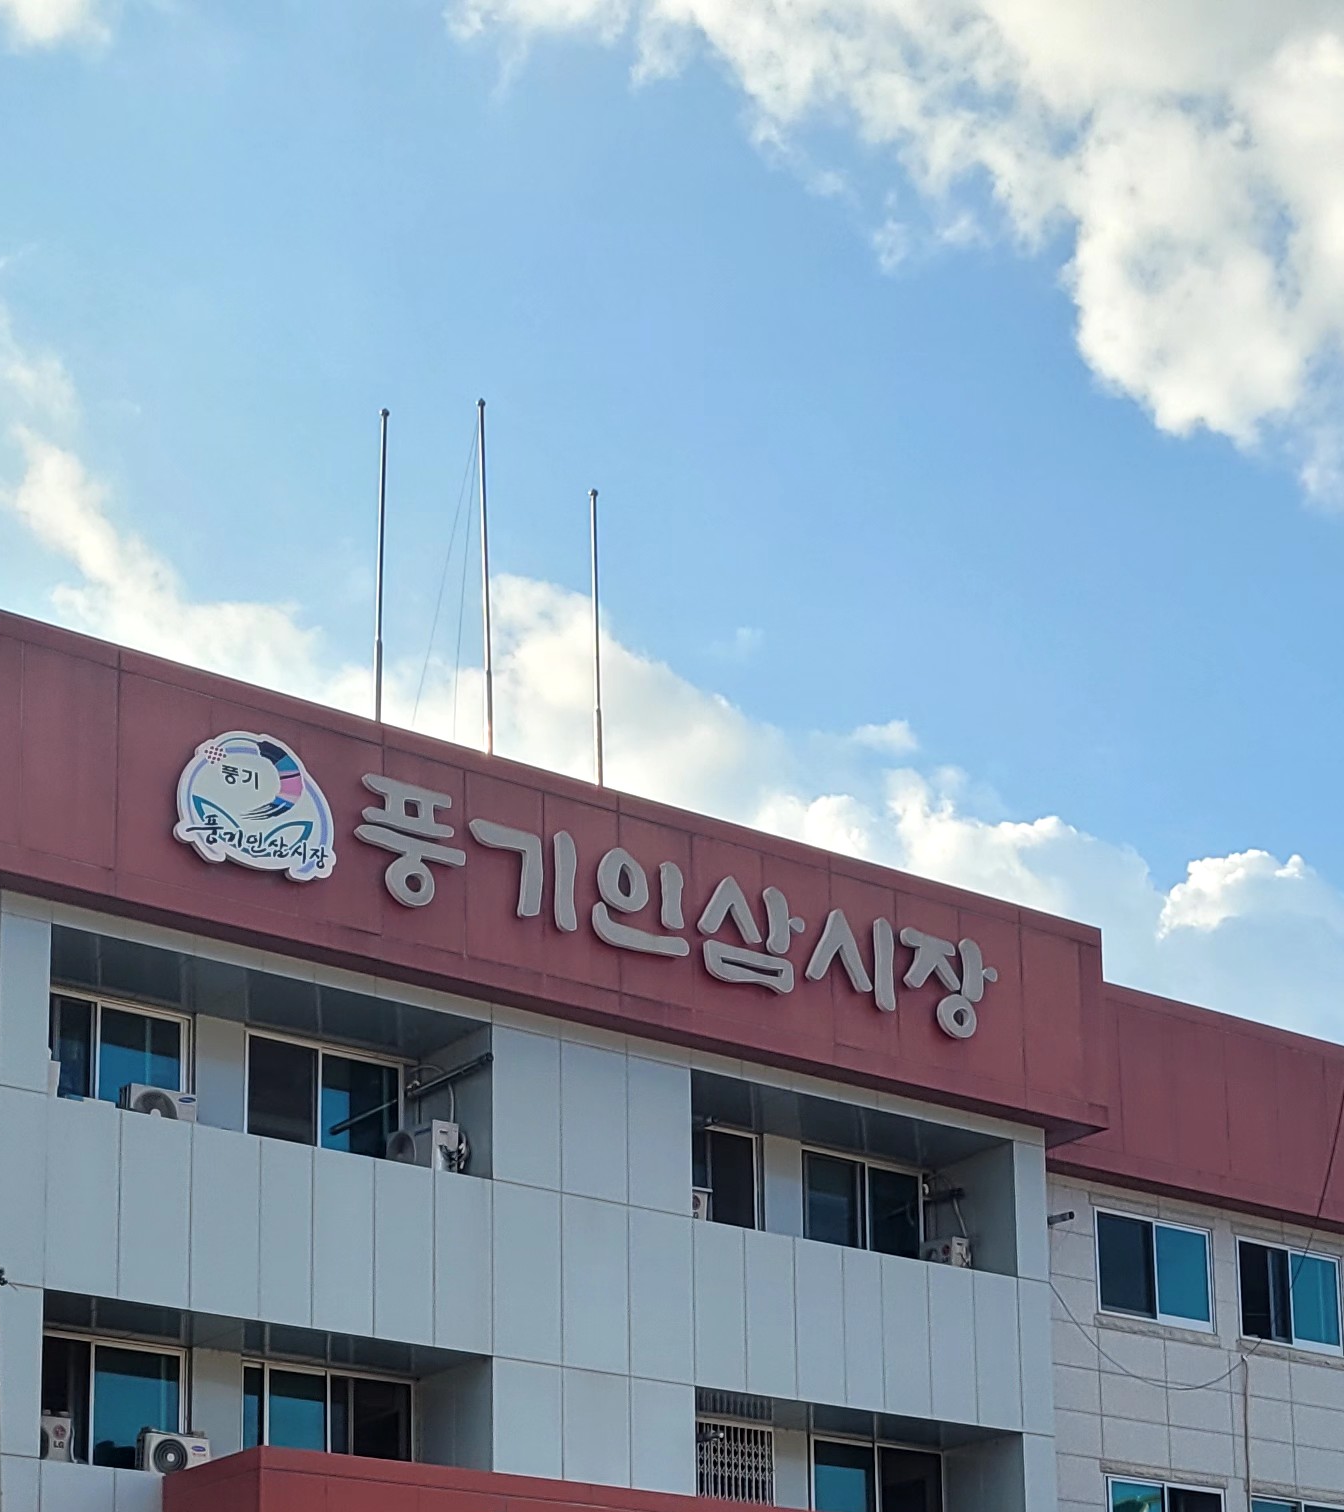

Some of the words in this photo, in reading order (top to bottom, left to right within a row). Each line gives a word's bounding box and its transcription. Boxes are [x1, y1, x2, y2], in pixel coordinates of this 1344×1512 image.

[221, 764, 260, 791] 풍기
[185, 813, 329, 869] 풍기인삼시장
[353, 771, 999, 1041] 풍기인삼시장
[53, 1440, 65, 1450] LG
